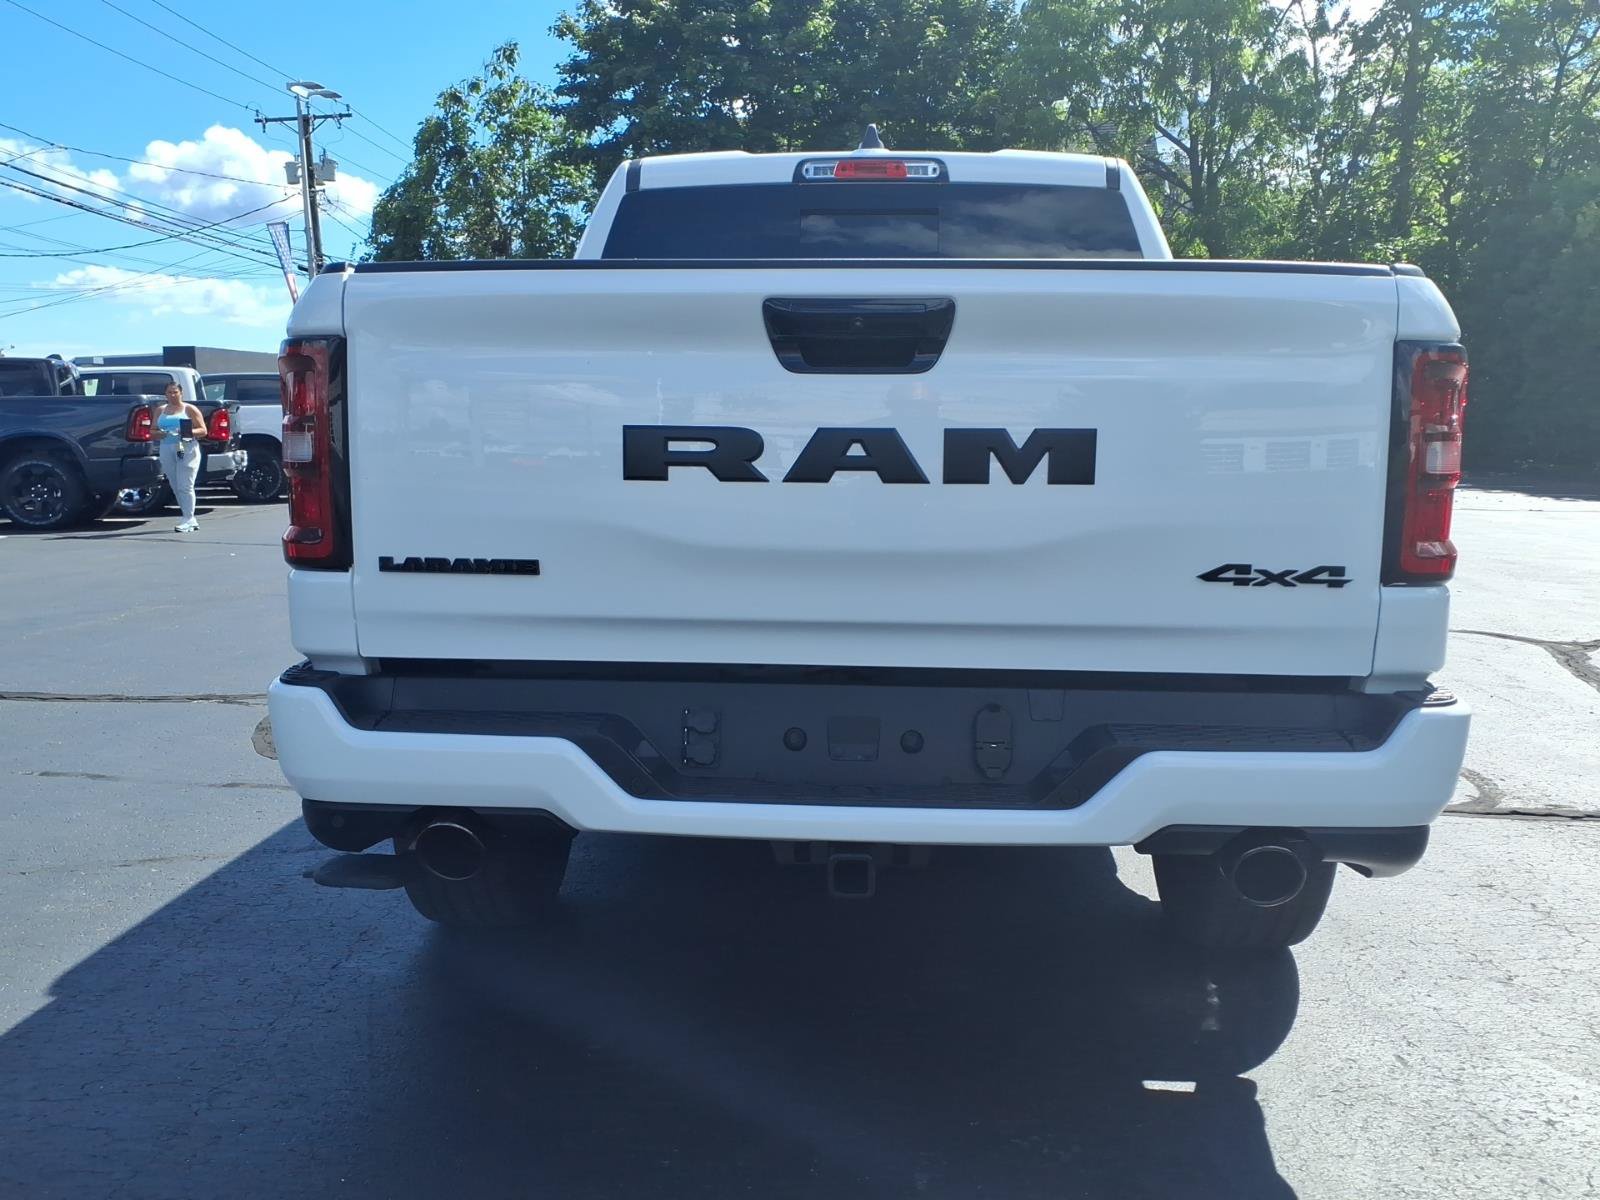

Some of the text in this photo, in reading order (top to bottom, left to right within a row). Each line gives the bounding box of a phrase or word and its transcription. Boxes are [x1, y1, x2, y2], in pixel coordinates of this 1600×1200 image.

[623, 425, 1097, 485] RAM
[379, 556, 540, 575] LARAMIE
[1196, 564, 1354, 588] 4x4
